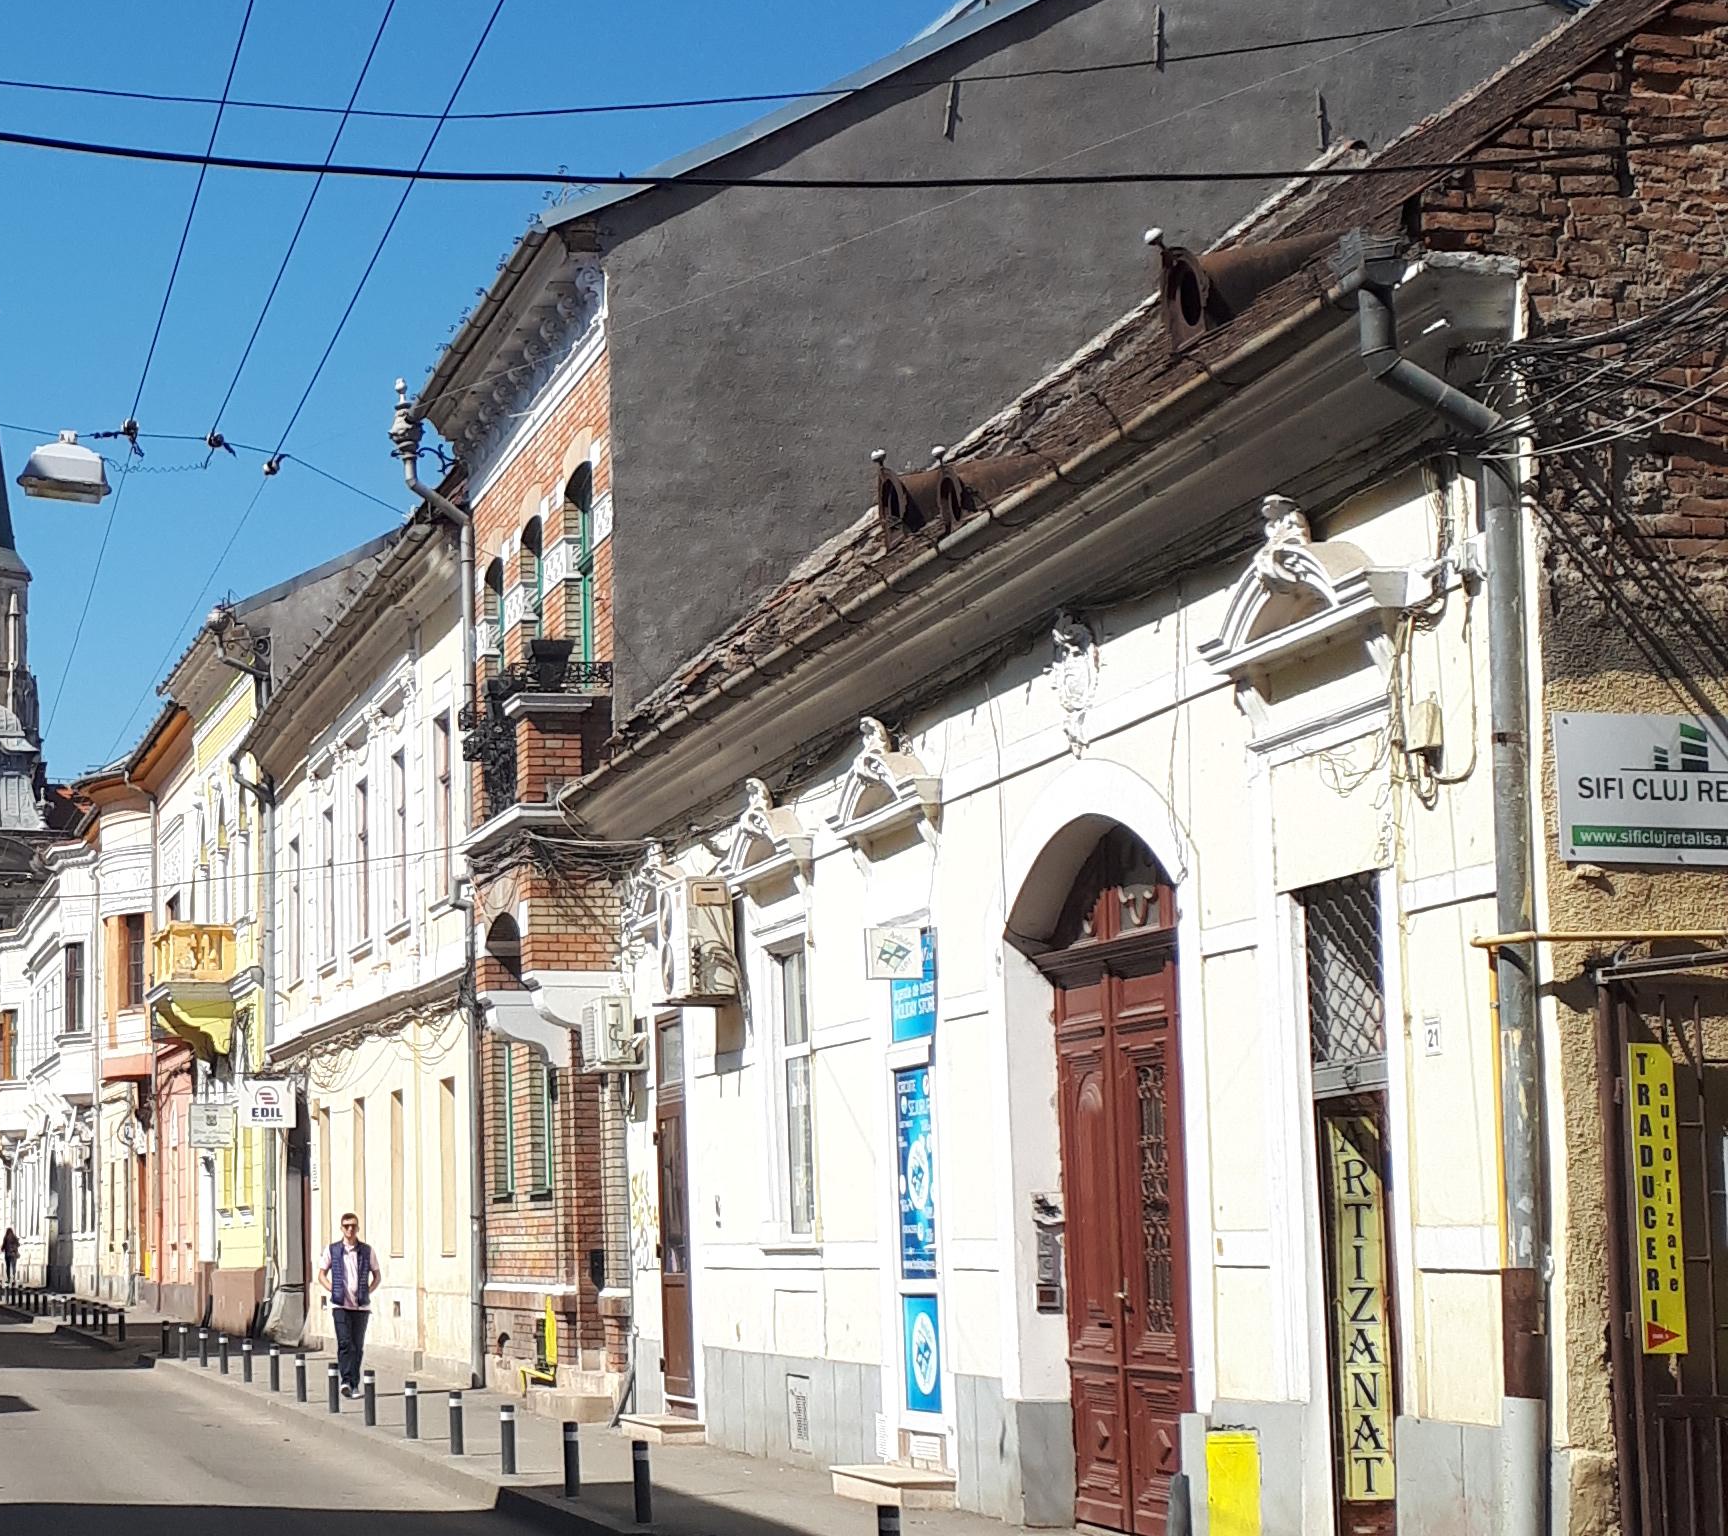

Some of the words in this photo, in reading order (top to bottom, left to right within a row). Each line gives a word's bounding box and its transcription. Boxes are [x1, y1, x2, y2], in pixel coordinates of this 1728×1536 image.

[1578, 776, 1624, 800] SIFI
[1632, 778, 1688, 802] CLUJ
[1427, 1028, 1439, 1048] 21
[252, 1107, 283, 1118] EDIL
[1635, 1052, 1660, 1322] TRADUCERI
[1659, 1081, 1679, 1292] autorizate
